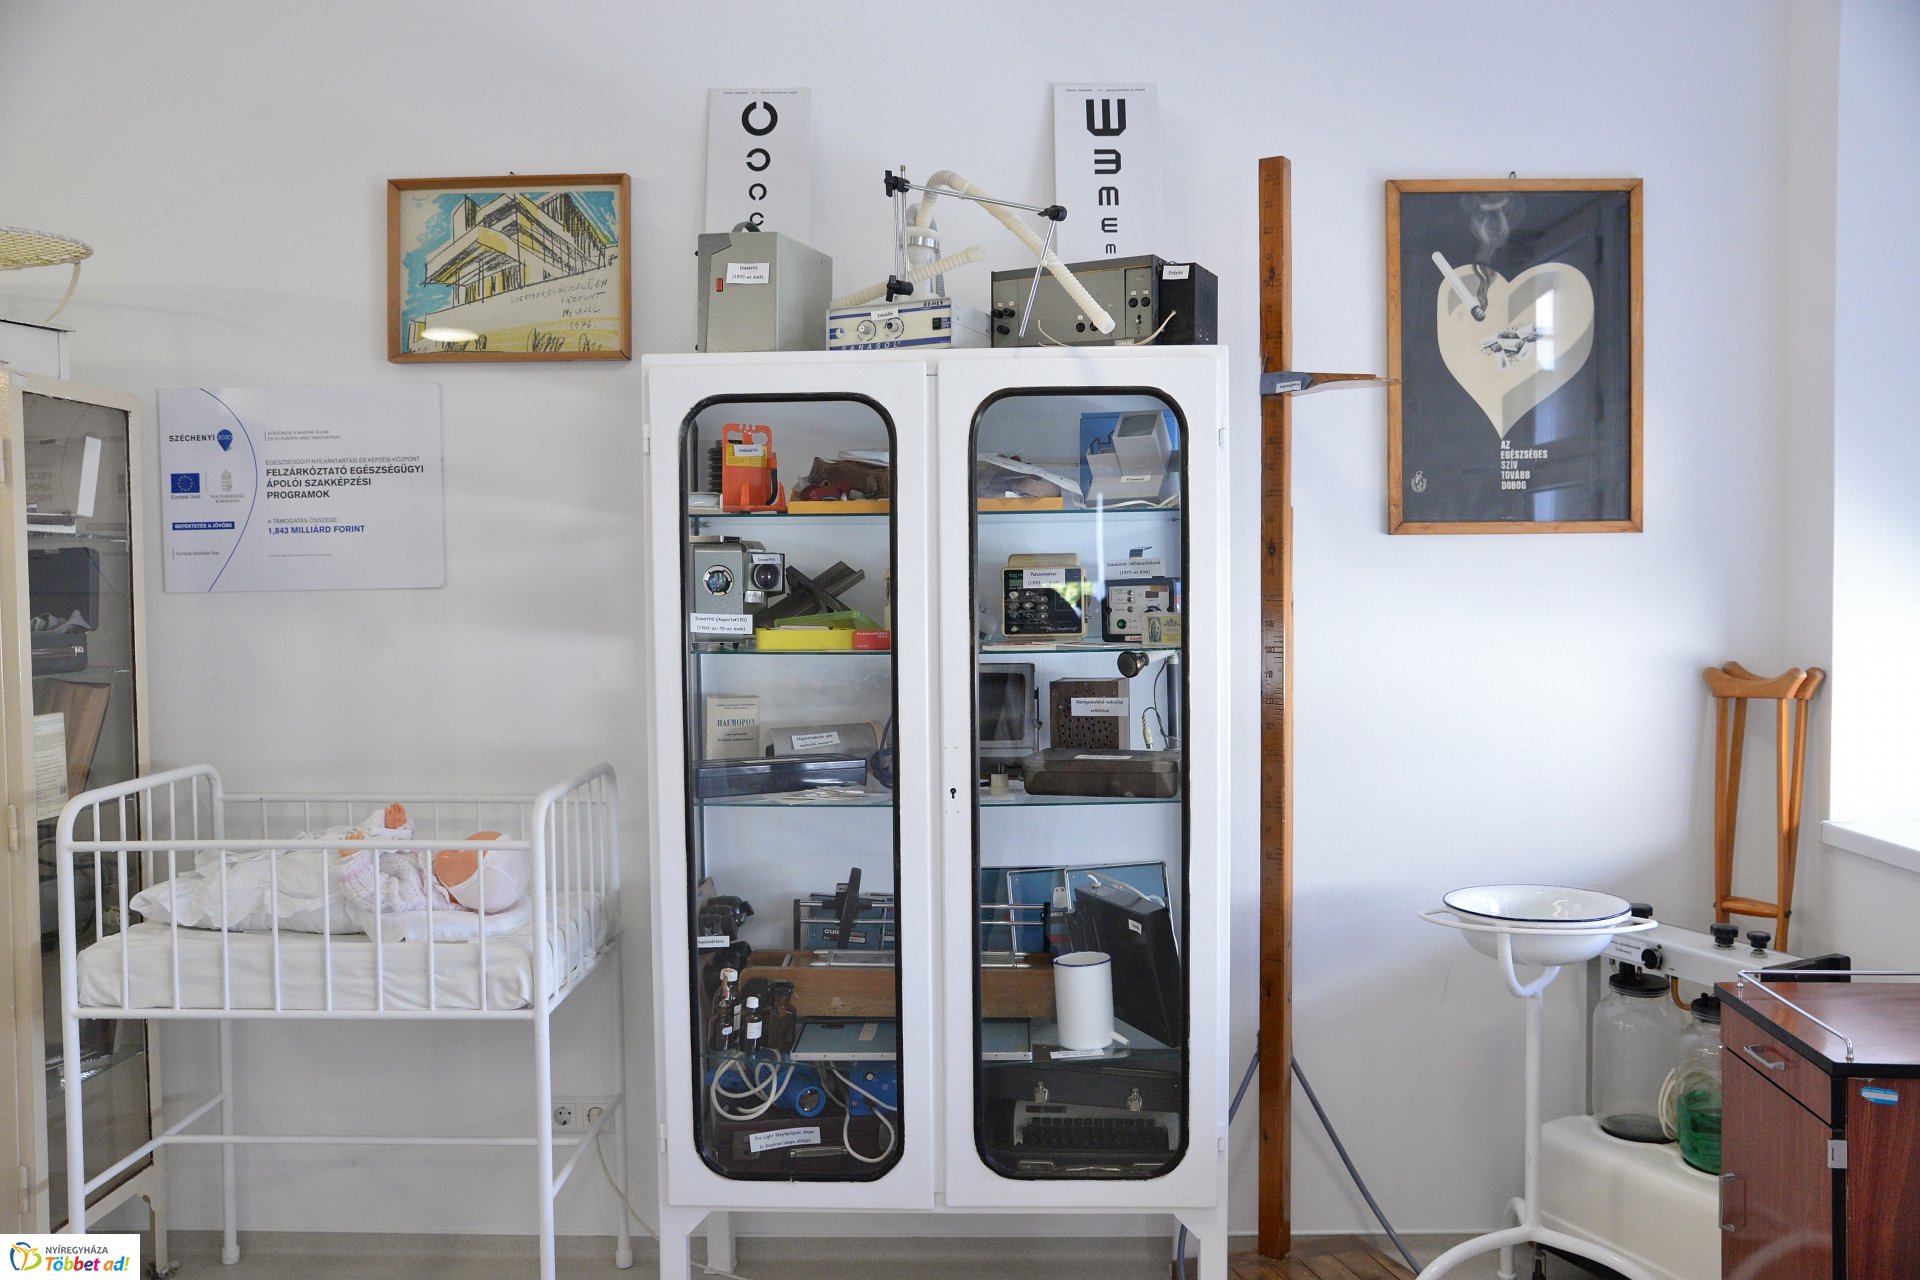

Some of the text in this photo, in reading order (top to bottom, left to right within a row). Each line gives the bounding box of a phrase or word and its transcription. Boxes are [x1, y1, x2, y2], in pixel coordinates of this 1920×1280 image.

[169, 434, 215, 442] SZÉCHENYI
[1501, 440, 1510, 449] AZ
[1501, 448, 1548, 459] EGÉSZSÉGES
[1501, 460, 1518, 469] SZÍV
[266, 464, 424, 476] FELZÁRKÓZTATÓ EGÉSZSÉGÜGYI
[1501, 470, 1530, 479] TOVÁBB
[267, 476, 371, 488] ÁPOLÓI SZAKKÉPZÉSI
[1502, 481, 1526, 490] DOBOG
[267, 490, 330, 499] PROGRAMOK
[268, 527, 288, 535] 1,843
[291, 524, 331, 533] MILLIÁRD
